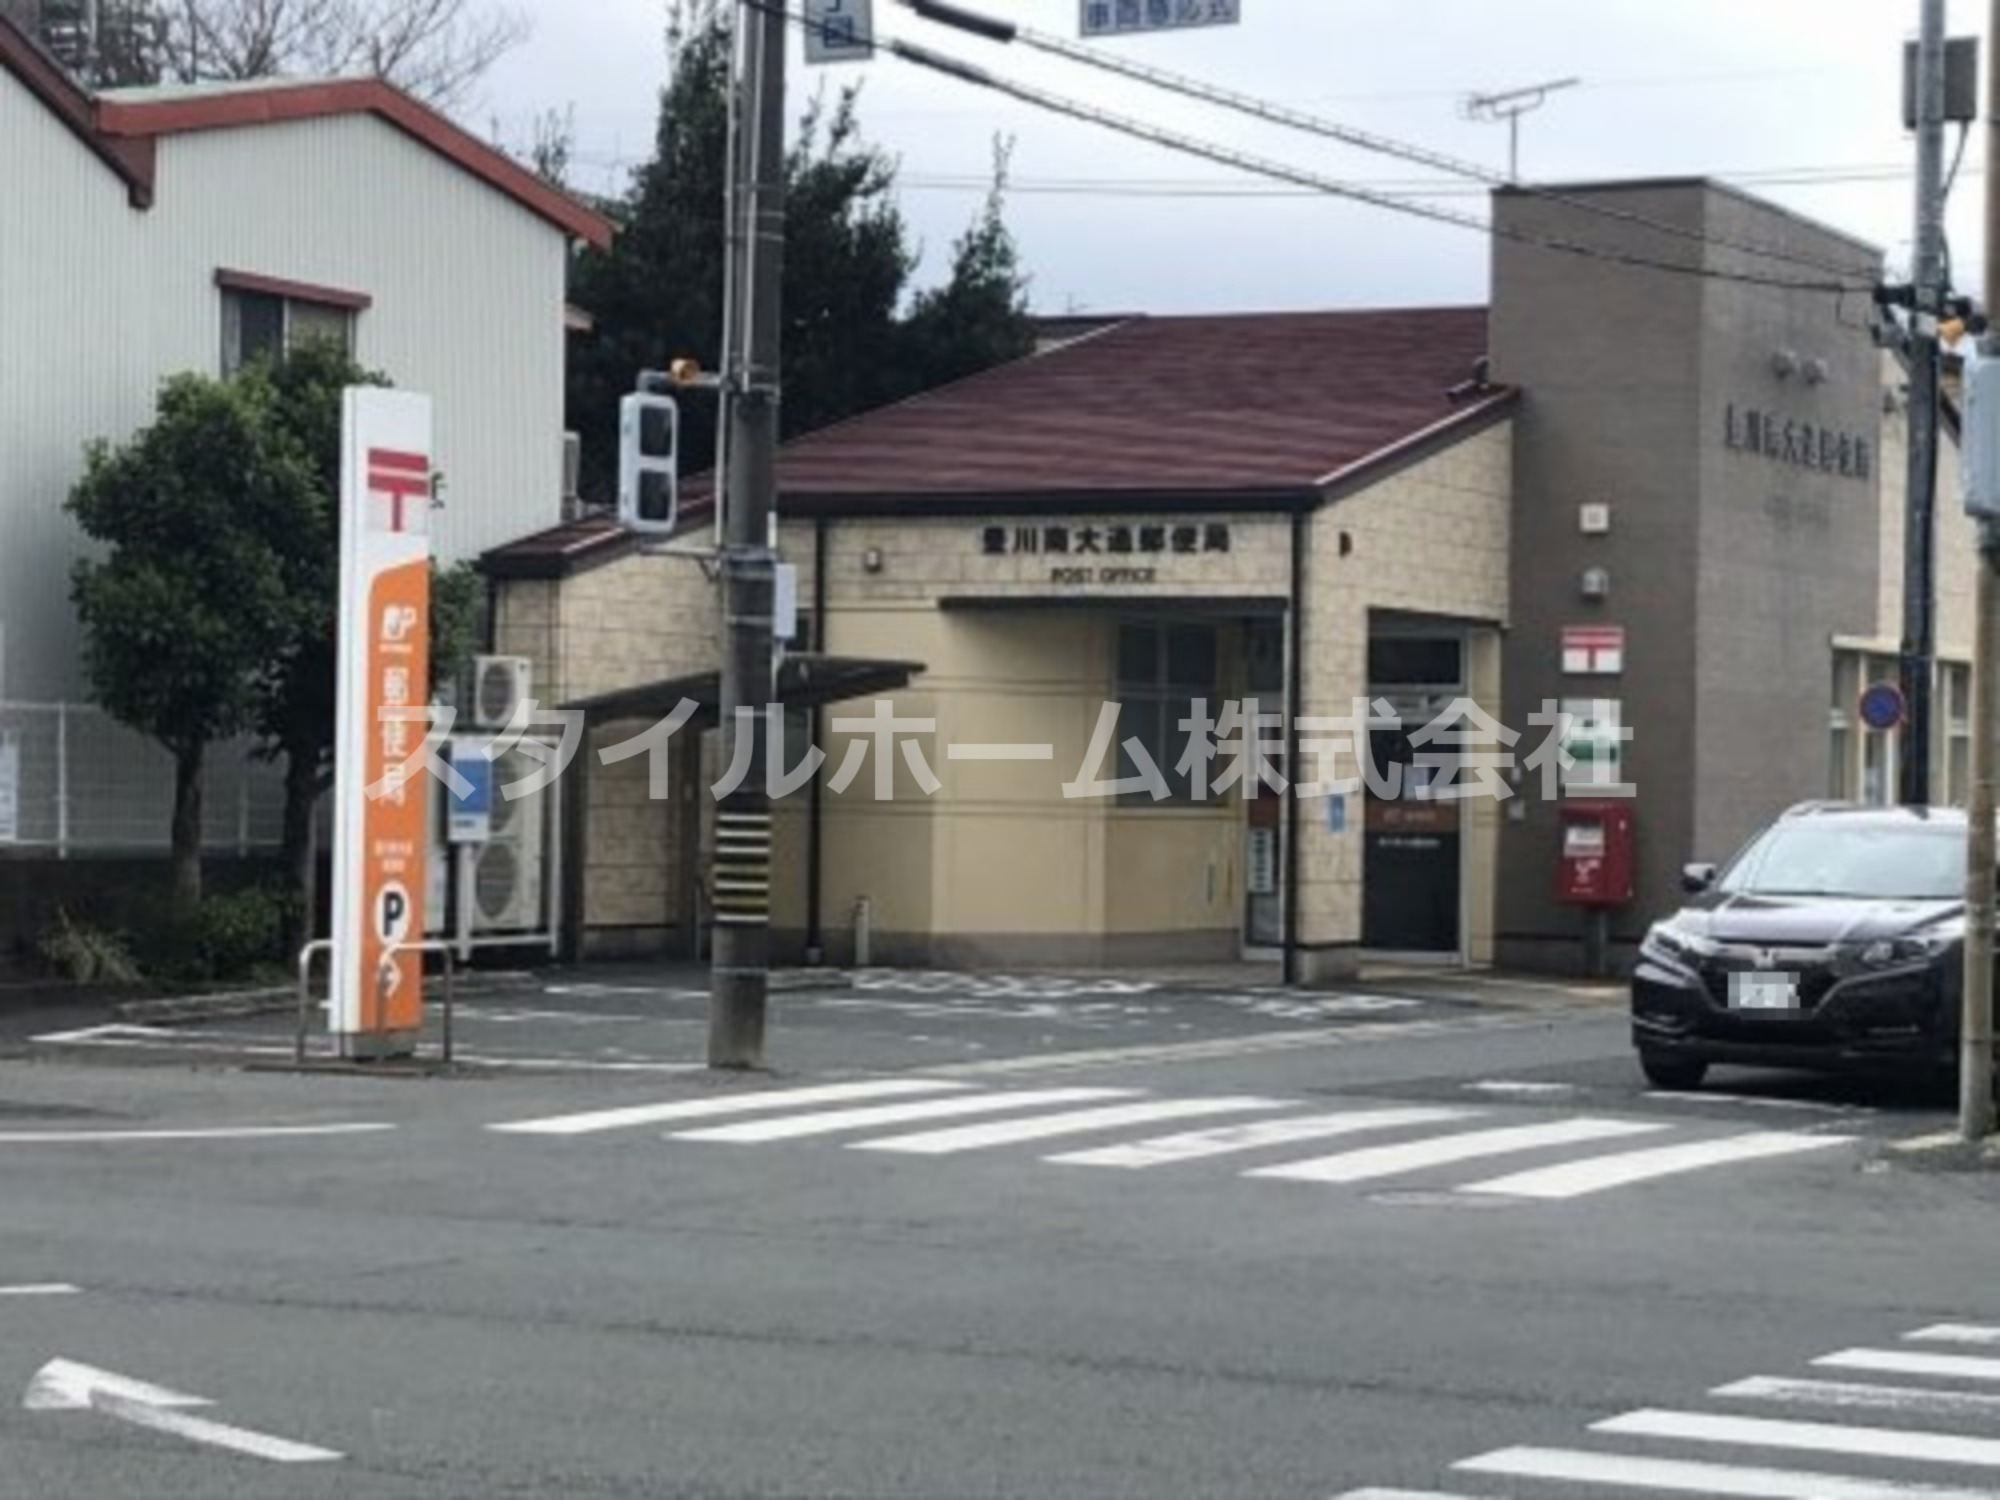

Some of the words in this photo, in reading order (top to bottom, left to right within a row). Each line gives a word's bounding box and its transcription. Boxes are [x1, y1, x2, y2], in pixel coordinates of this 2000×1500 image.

[1052, 567, 1093, 584] POST
[1099, 567, 1155, 584] OFFICE
[383, 890, 405, 937] P
